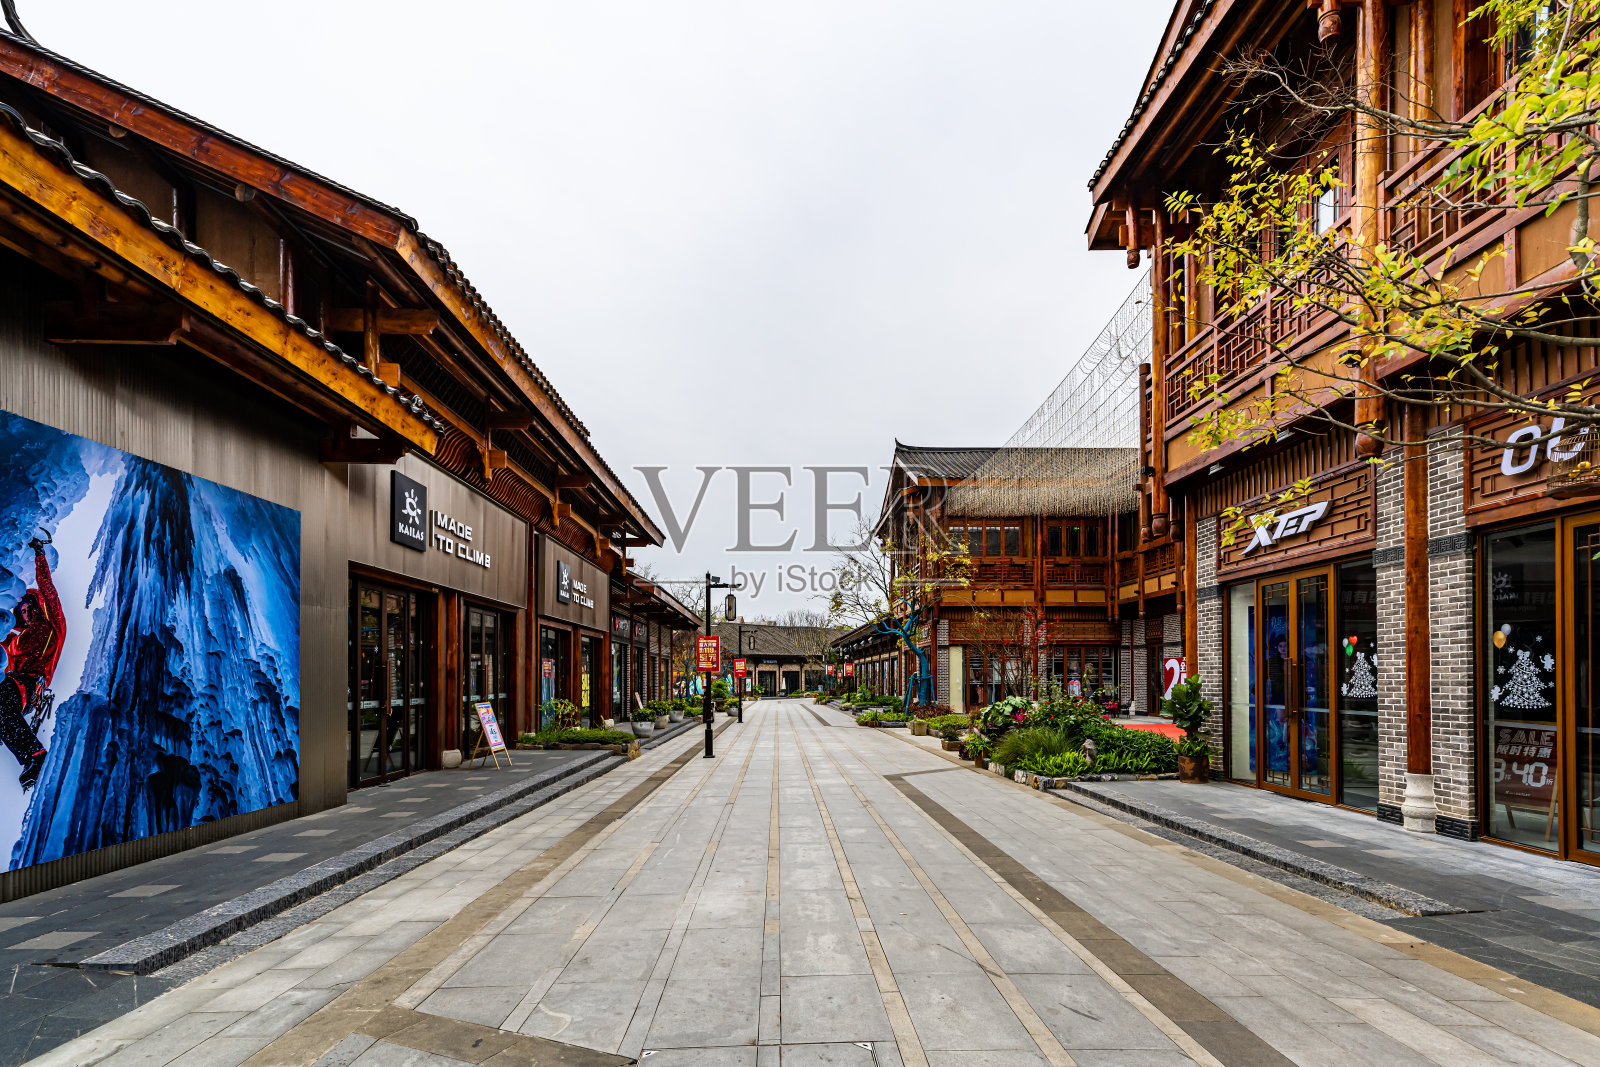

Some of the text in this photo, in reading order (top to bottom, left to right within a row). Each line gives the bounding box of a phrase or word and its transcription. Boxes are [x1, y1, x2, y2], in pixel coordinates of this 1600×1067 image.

[398, 521, 425, 543] KAILAS
[437, 510, 473, 542] MADE
[1239, 501, 1329, 556] XTEP
[434, 533, 491, 569] TO CLIMB
[573, 579, 587, 594] MADE
[572, 592, 579, 603] TO
[1499, 728, 1555, 747] SALE
[1496, 744, 1552, 758] 限时特惠
